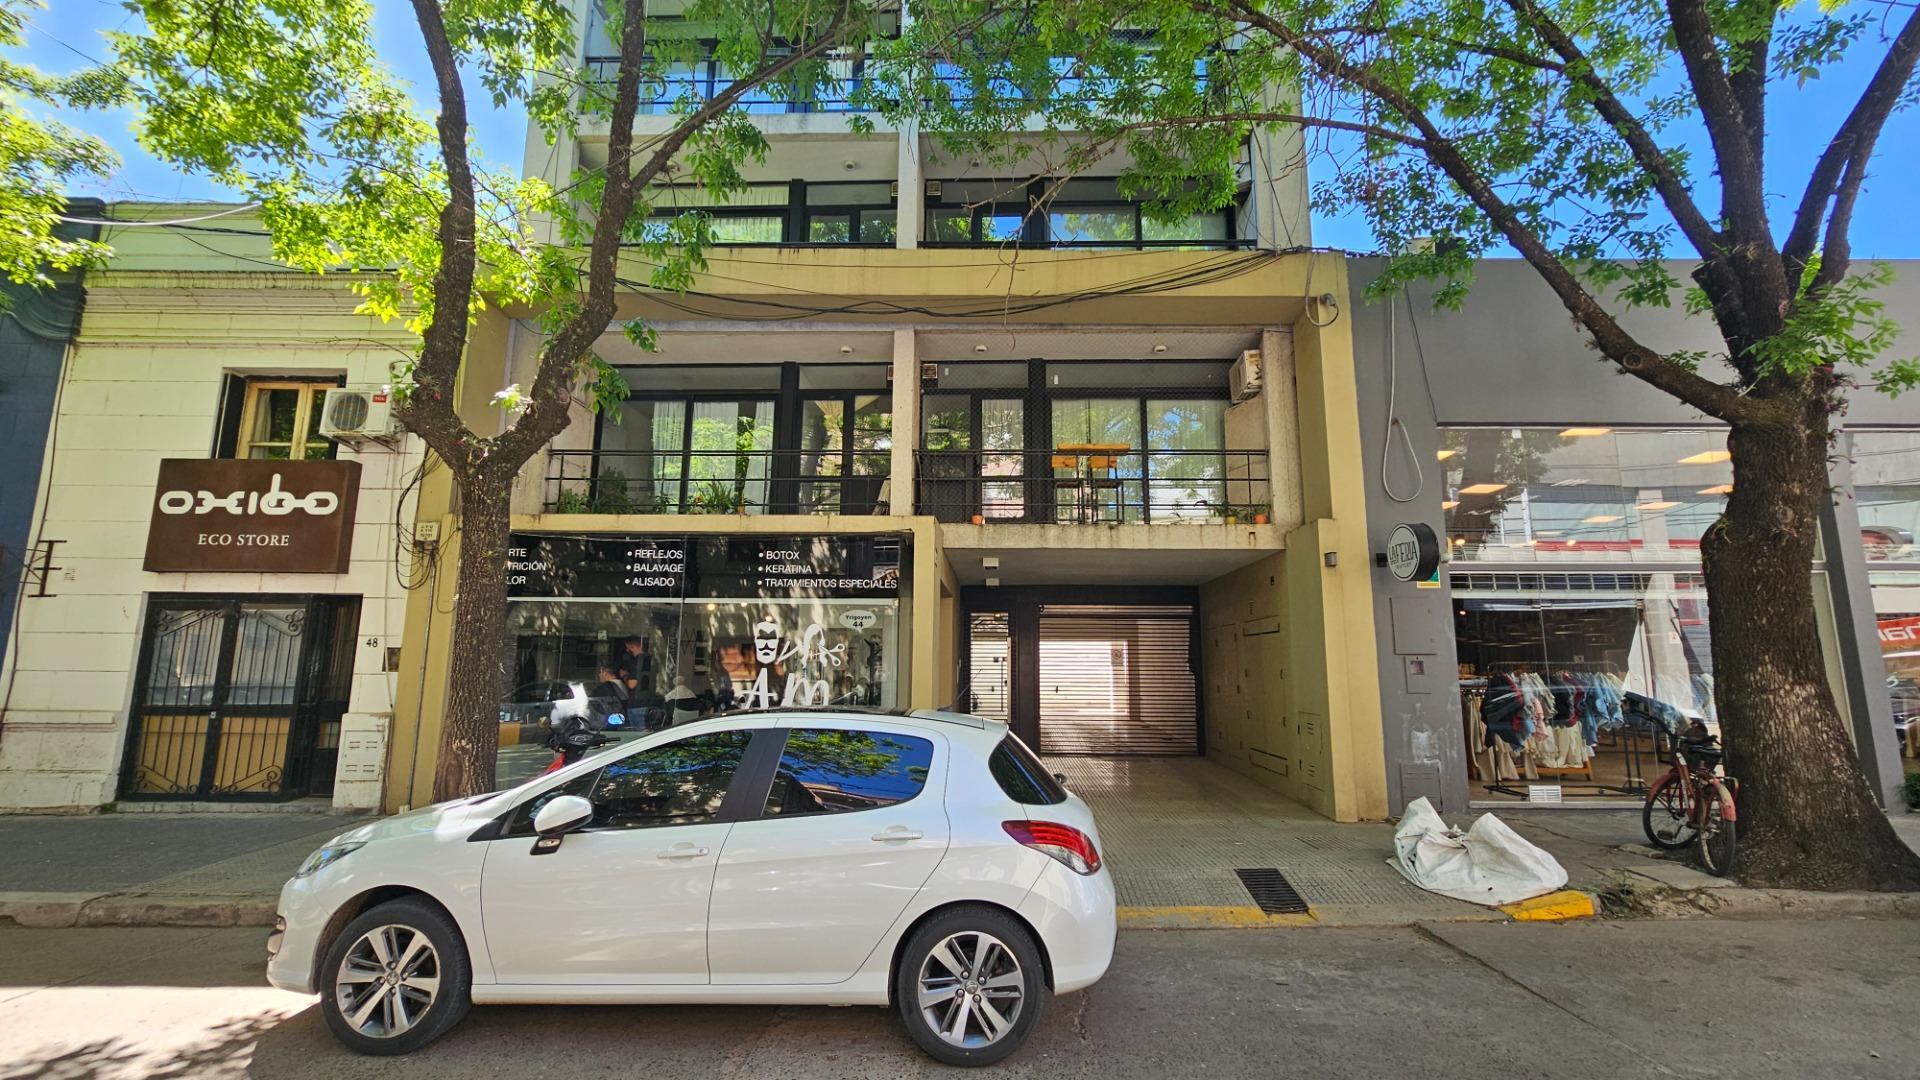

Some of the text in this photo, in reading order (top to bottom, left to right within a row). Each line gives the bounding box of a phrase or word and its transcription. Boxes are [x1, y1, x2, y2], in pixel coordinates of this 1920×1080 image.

[197, 533, 290, 546] ECO STORE
[508, 548, 527, 557] RTE
[634, 549, 683, 559] REFLEJOS
[765, 550, 800, 560] BOTOX
[507, 560, 547, 571] TRICIÓN
[633, 563, 684, 573] BALAYAGE
[765, 565, 812, 574] KERATINA
[506, 575, 527, 585] LOR
[632, 577, 675, 587] ALISADO
[765, 578, 897, 589] TRATAMIENTOS ESPECIALES
[366, 637, 378, 648] 48
